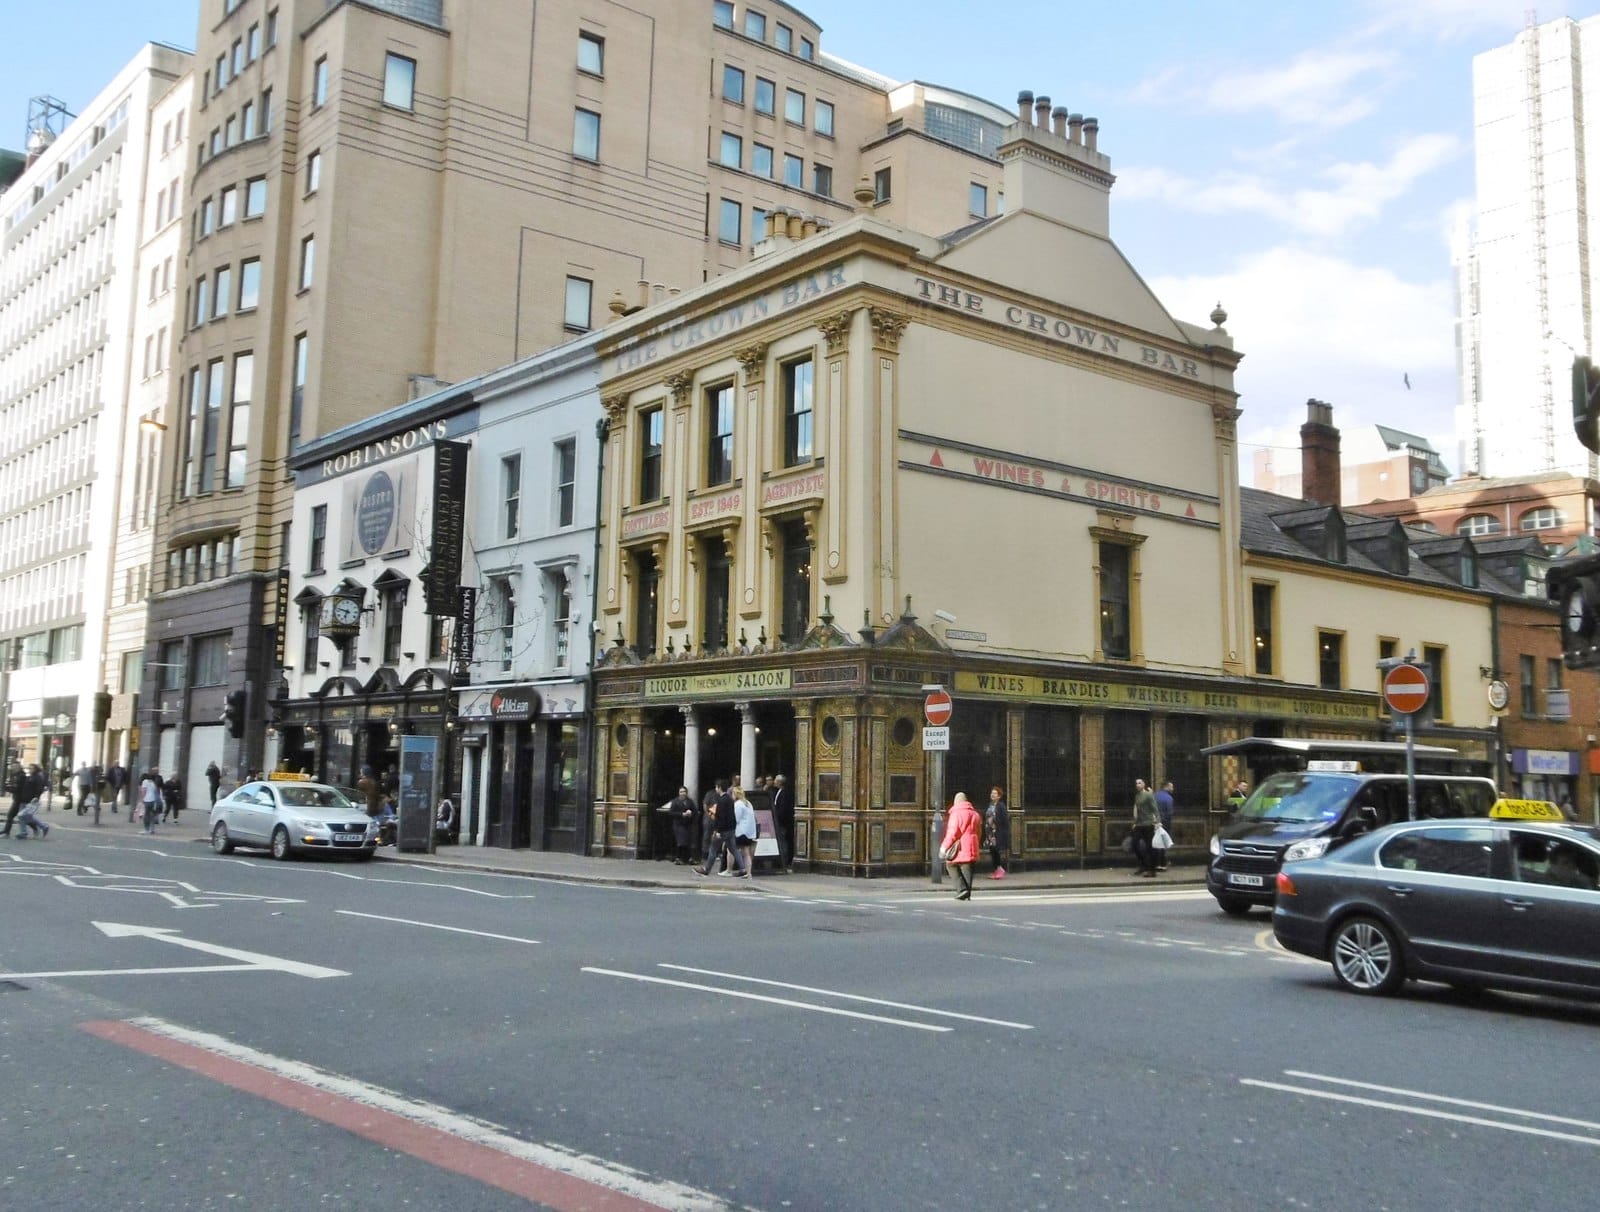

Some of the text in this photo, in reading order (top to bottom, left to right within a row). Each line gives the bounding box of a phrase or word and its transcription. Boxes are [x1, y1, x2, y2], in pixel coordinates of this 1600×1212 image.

[615, 263, 846, 373] THE CROWN BAR
[915, 277, 1198, 377] THE CROWN BAR
[322, 419, 447, 477] ROBINSON'S
[439, 447, 453, 490] DAILY
[717, 495, 740, 514] 1849
[973, 457, 1161, 511] WINES & SPIRITS
[436, 493, 451, 555] SERVED
[462, 589, 471, 619] mark
[650, 679, 688, 693] LIQUOR
[736, 671, 784, 688] SALOON
[977, 675, 1024, 692] WINES
[1043, 680, 1109, 699] BRANDIES
[1127, 687, 1189, 704] WHISKIES
[1293, 701, 1328, 715] LIQUOR
[925, 730, 946, 739] Except
[926, 738, 946, 747] cycles
